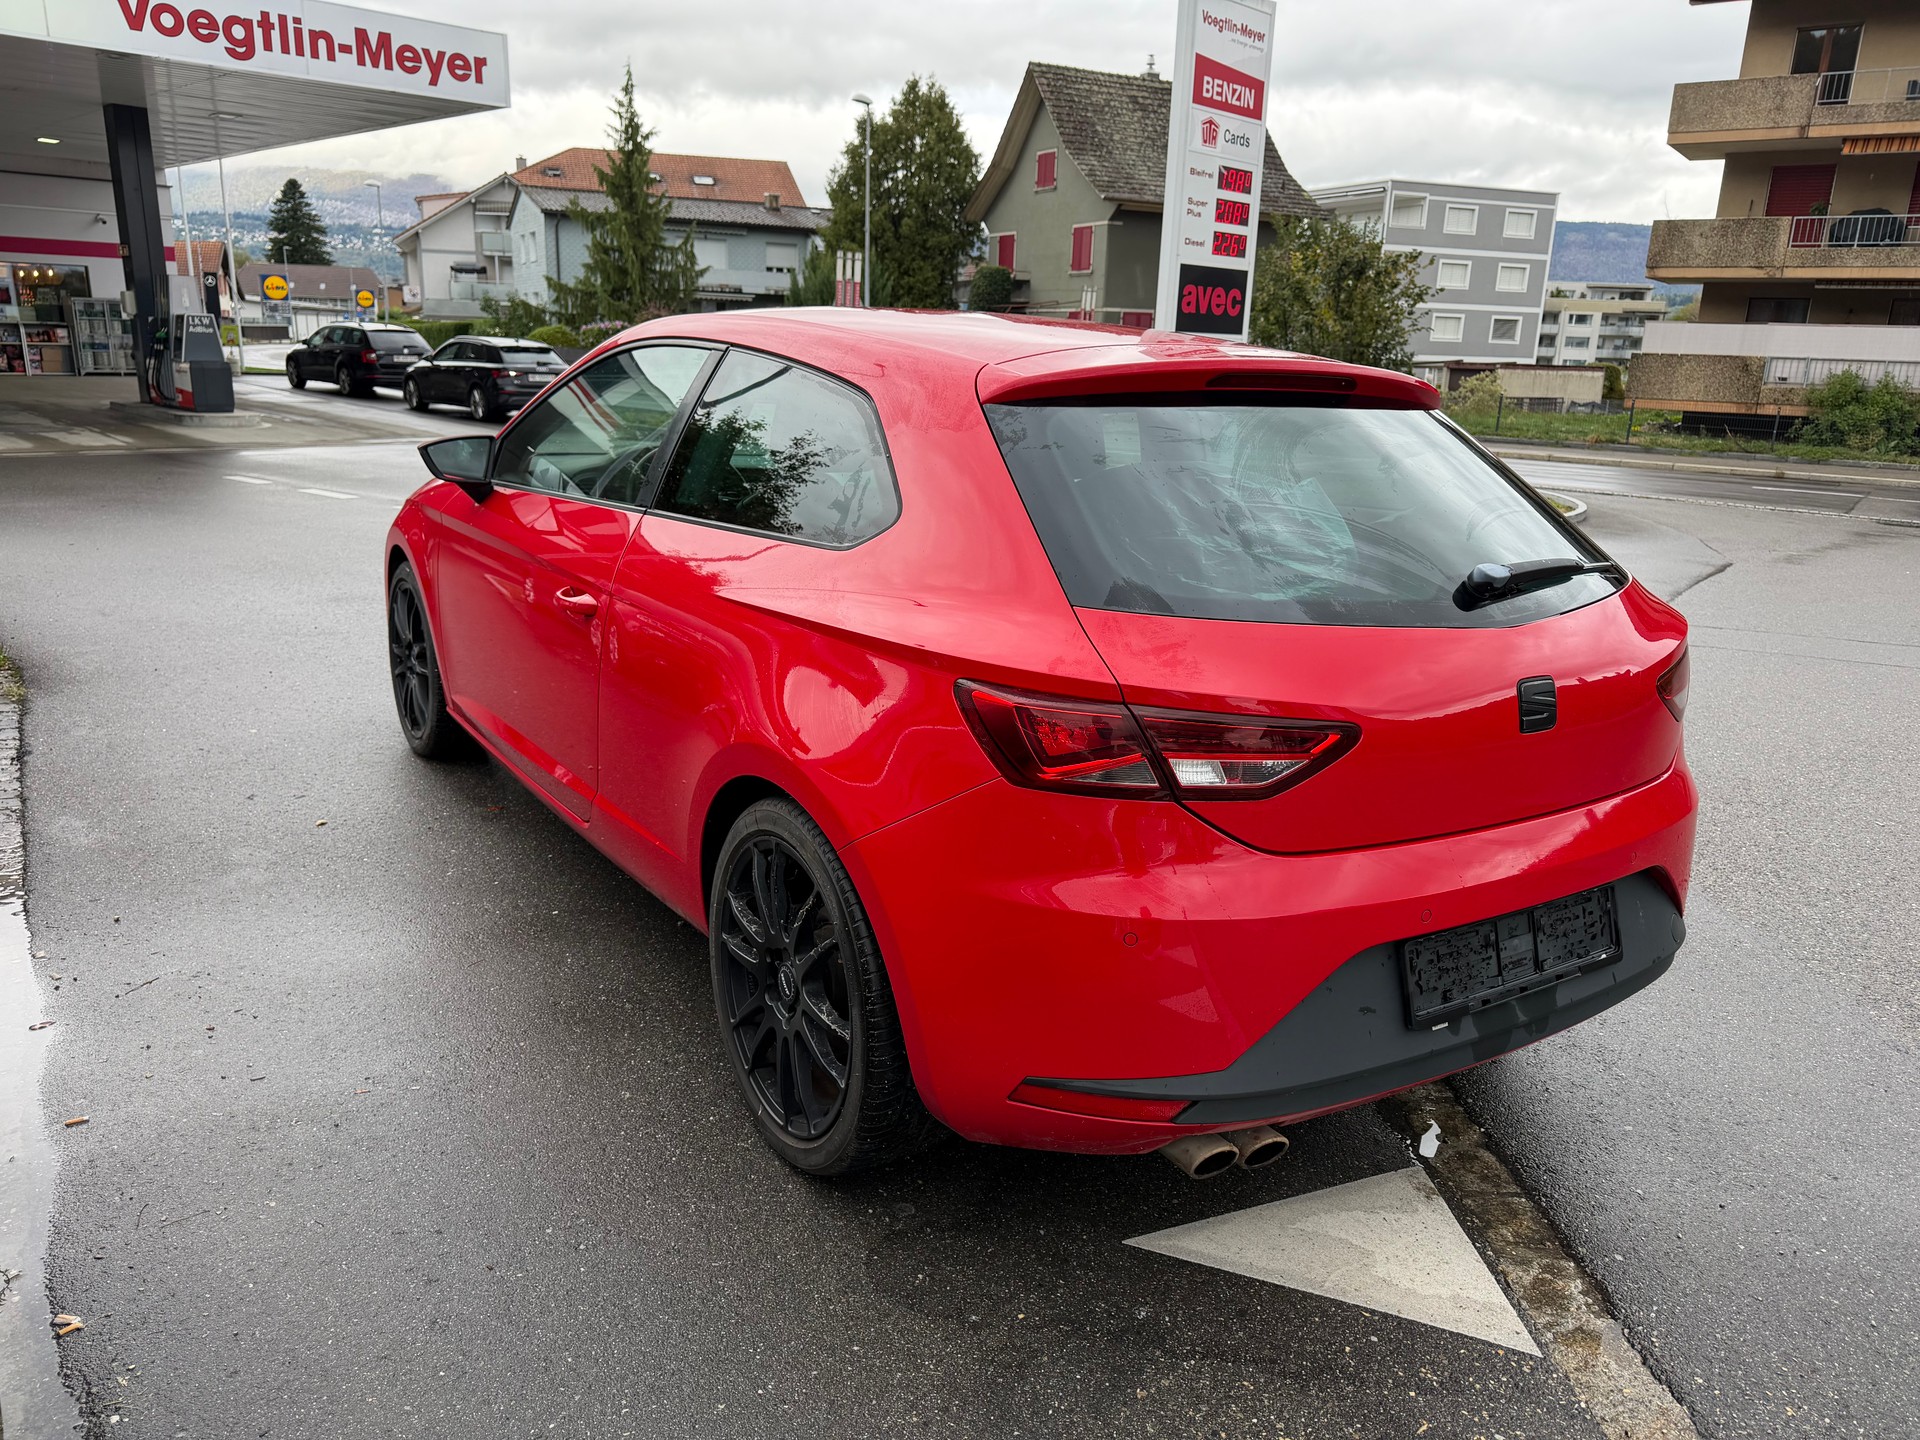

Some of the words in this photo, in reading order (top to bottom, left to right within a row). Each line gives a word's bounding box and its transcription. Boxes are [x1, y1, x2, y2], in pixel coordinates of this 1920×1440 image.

[1202, 9, 1266, 43] Voegtlin-Meyer
[117, 0, 487, 86] Voegtlin-Meyer
[1202, 75, 1255, 109] BENZIN
[1223, 128, 1251, 148] Cards
[1189, 167, 1214, 179] Bleifrei
[1187, 197, 1208, 208] Super
[1186, 208, 1202, 218] Plus
[1184, 237, 1206, 248] Diesel
[1181, 284, 1242, 317] avec
[188, 316, 211, 325] LKW
[188, 325, 214, 334] AdBlue
